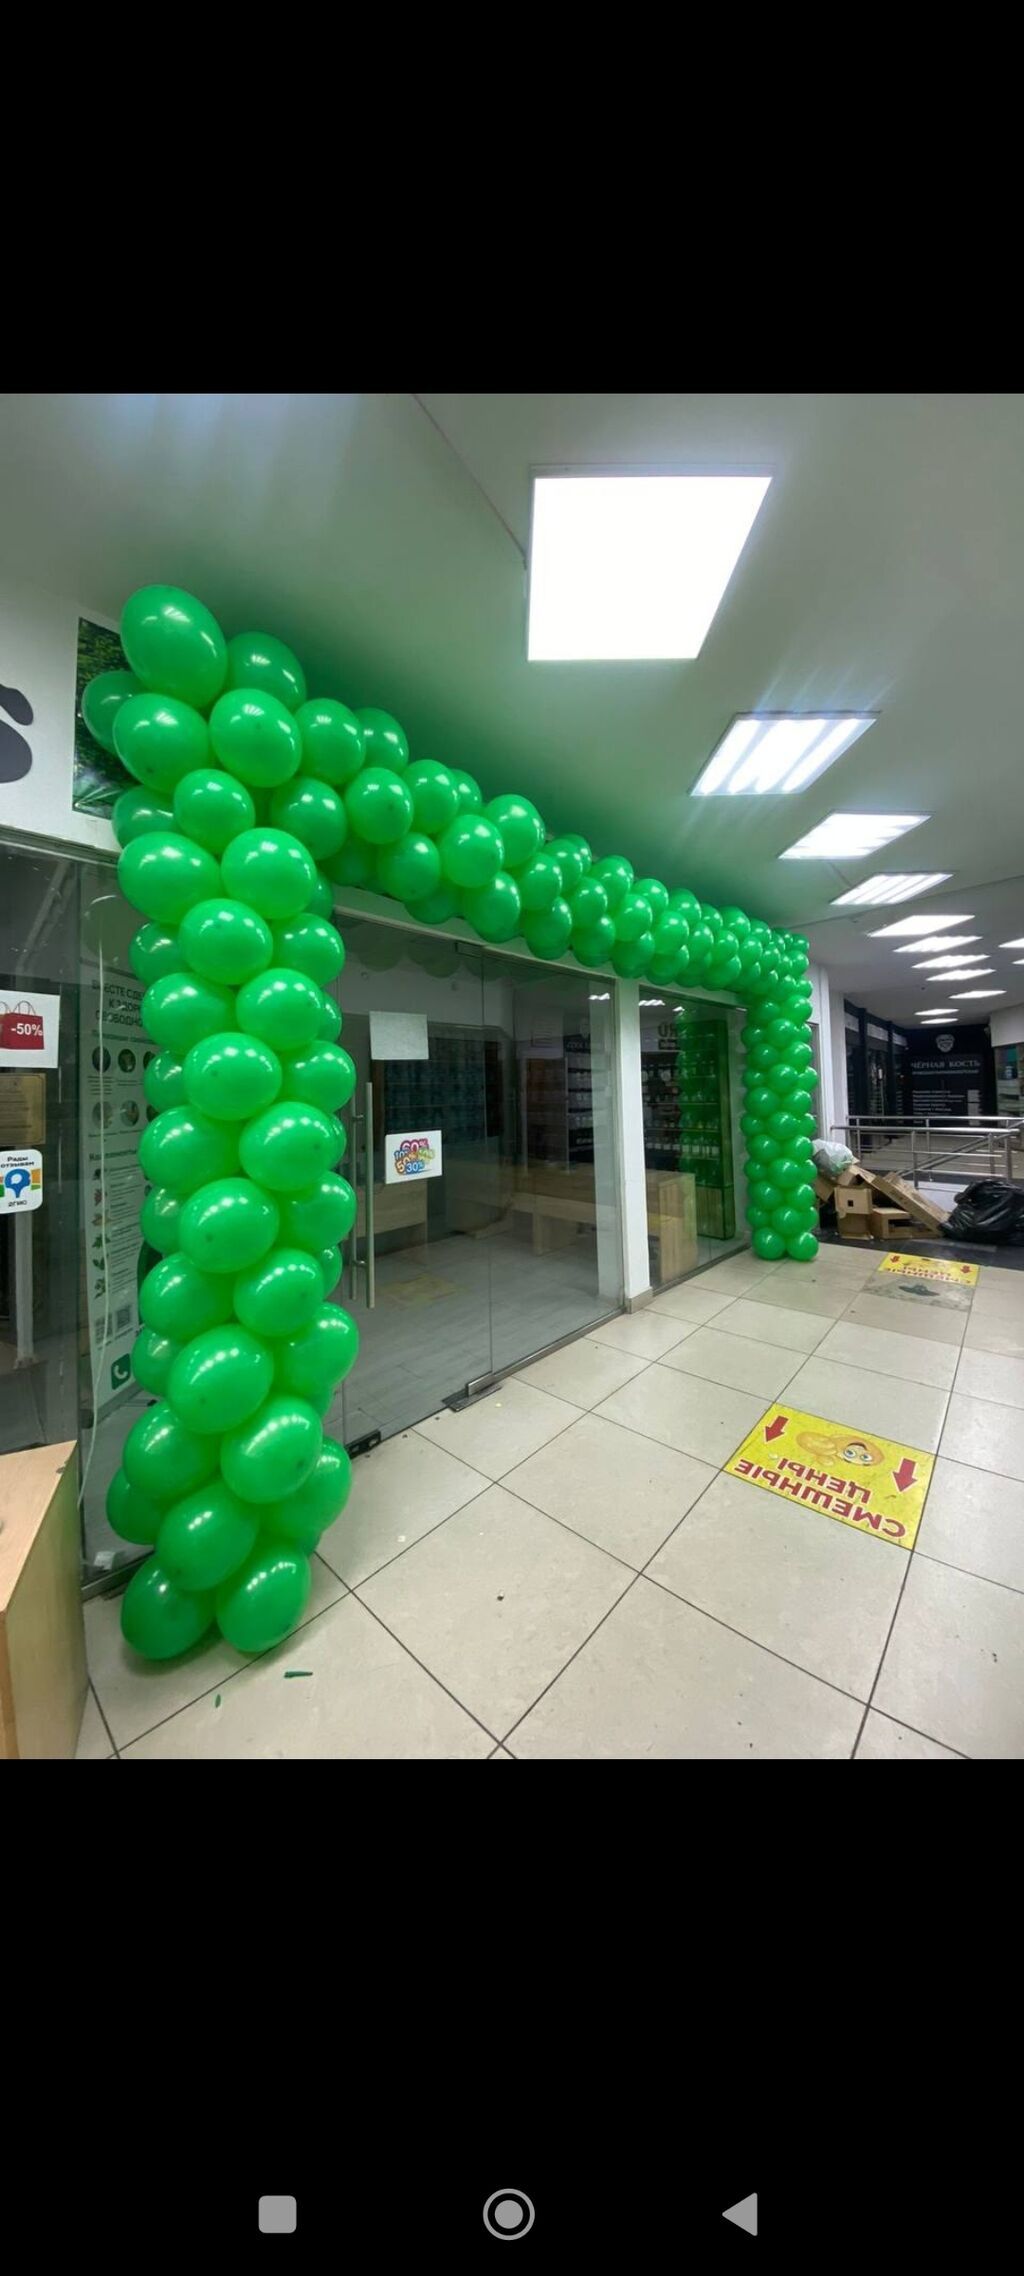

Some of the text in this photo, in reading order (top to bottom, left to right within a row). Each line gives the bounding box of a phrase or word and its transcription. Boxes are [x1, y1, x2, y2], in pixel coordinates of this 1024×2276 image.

[11, 1022, 44, 1037] -50%
[734, 1458, 906, 1538] СМЕШНЫЕ
[776, 1457, 872, 1504] ЦЕНЫ
